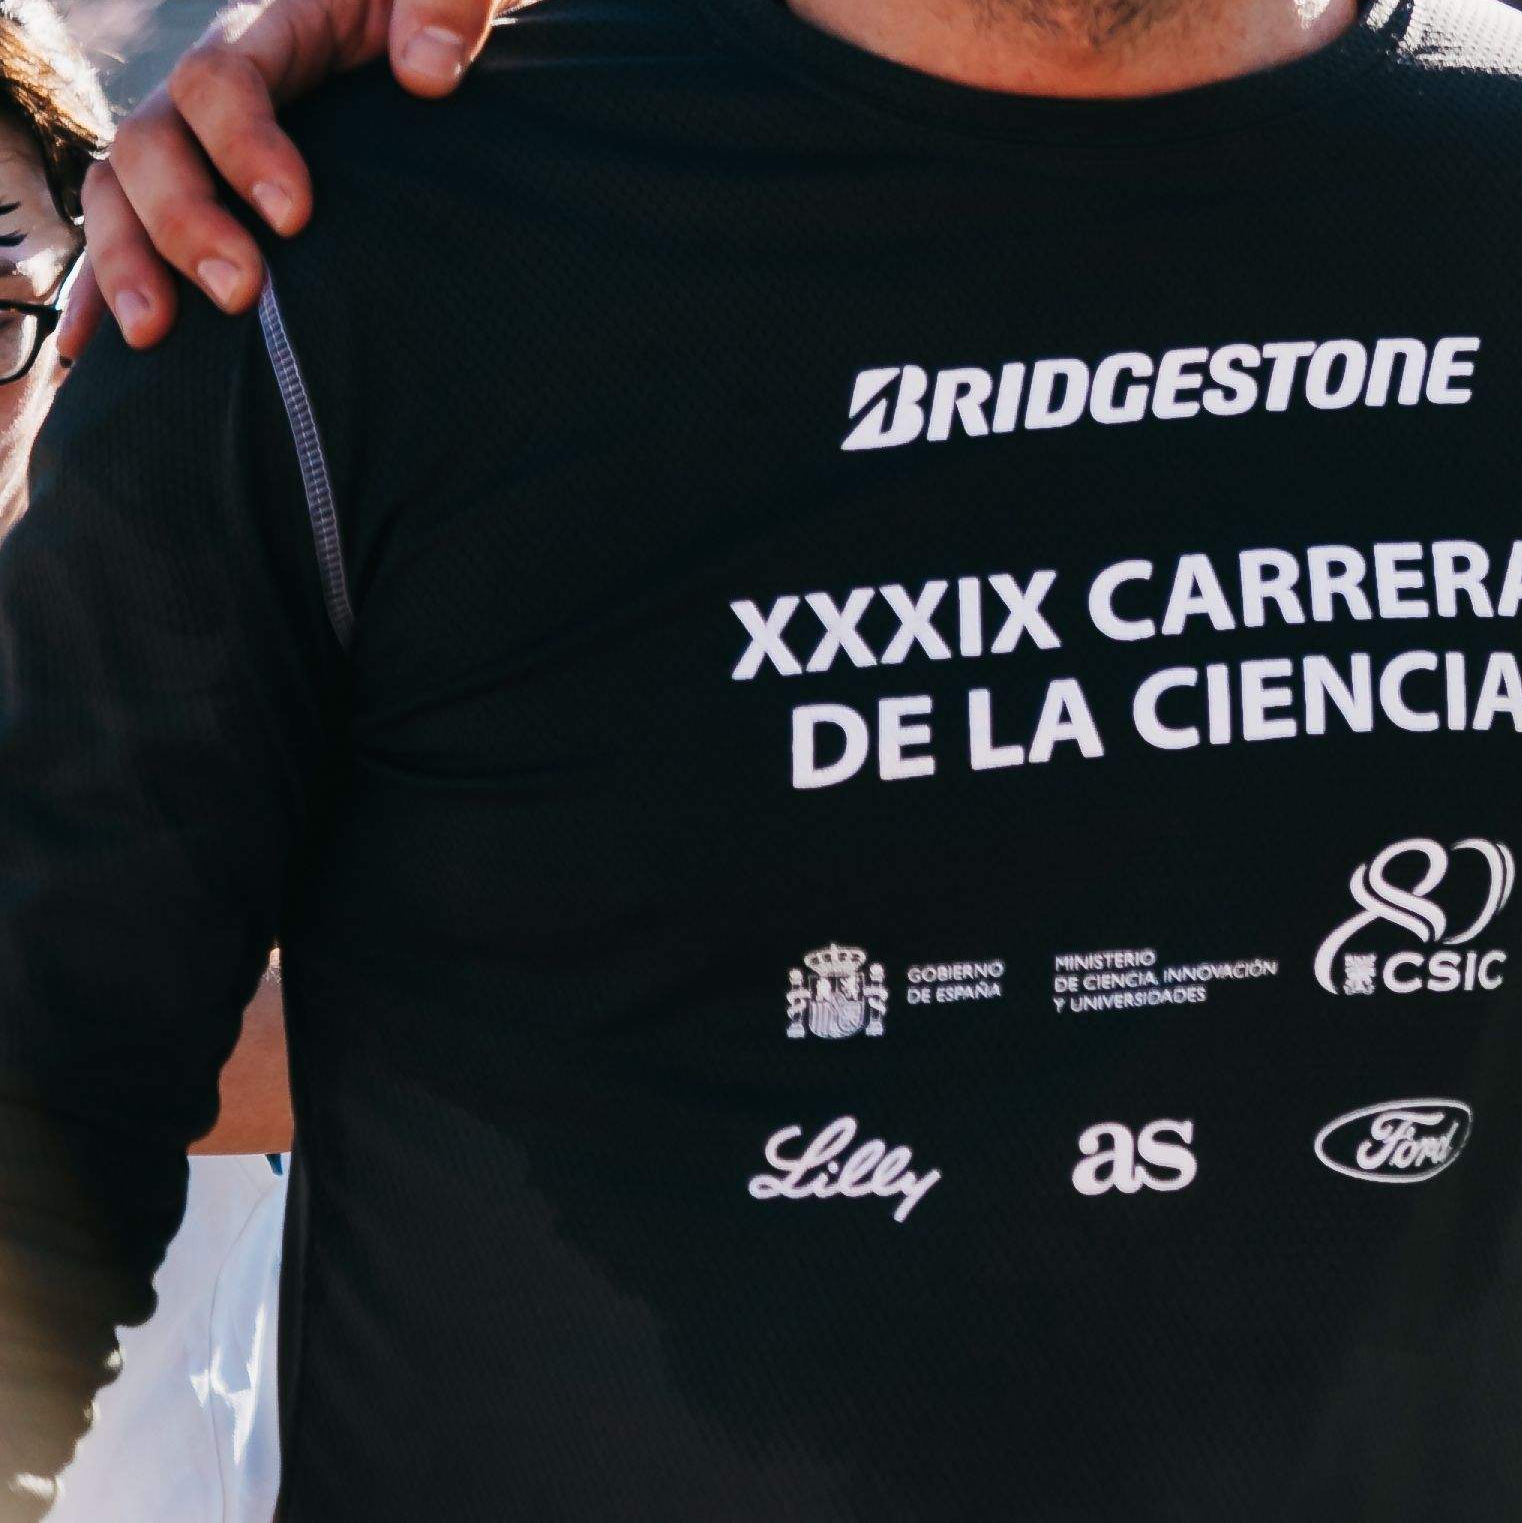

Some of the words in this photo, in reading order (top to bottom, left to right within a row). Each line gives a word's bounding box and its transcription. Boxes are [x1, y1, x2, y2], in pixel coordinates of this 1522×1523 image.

[841, 337, 1481, 450] BRIDGESTONE
[730, 570, 1061, 680] XXXIX
[791, 694, 936, 789] DE
[968, 677, 1105, 771] LA
[906, 958, 1005, 984] GOBIERNO
[1053, 973, 1080, 993] DE
[1163, 958, 1279, 984] INNOVACIÓN
[1055, 947, 1158, 972] MINISTERIO
[1382, 949, 1507, 994] CSIC
[906, 985, 932, 1005] DE
[935, 979, 1002, 1004] ESPAÑA
[1052, 997, 1067, 1014] Y
[1070, 983, 1208, 1013] UNIVERSIDADES
[1072, 1118, 1198, 1196] as
[1356, 1110, 1459, 1170] Ford
[748, 1116, 942, 1223] Lilly
